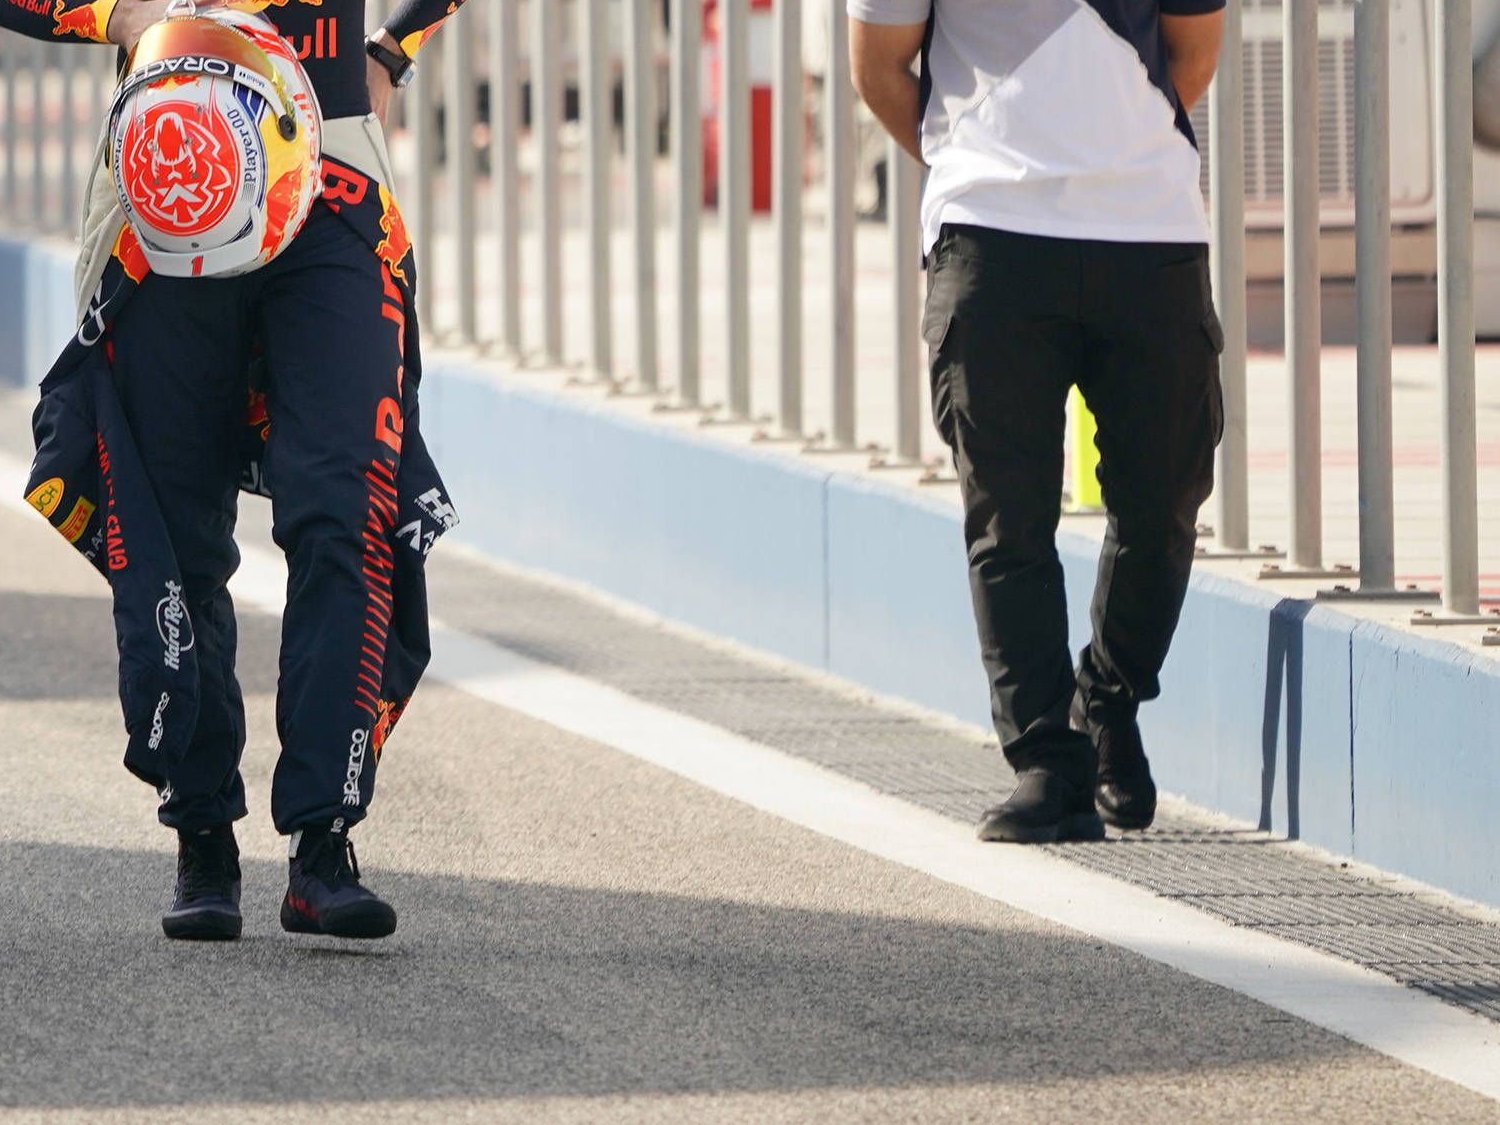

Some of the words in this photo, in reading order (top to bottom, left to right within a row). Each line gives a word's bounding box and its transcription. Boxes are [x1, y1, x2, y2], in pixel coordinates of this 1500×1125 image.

[286, 17, 337, 60] ull
[240, 128, 257, 183] Player
[190, 255, 204, 276] 1
[106, 514, 129, 571] GIVES
[164, 579, 183, 623] Rock
[163, 622, 182, 671] Hard
[147, 691, 171, 751] sparco
